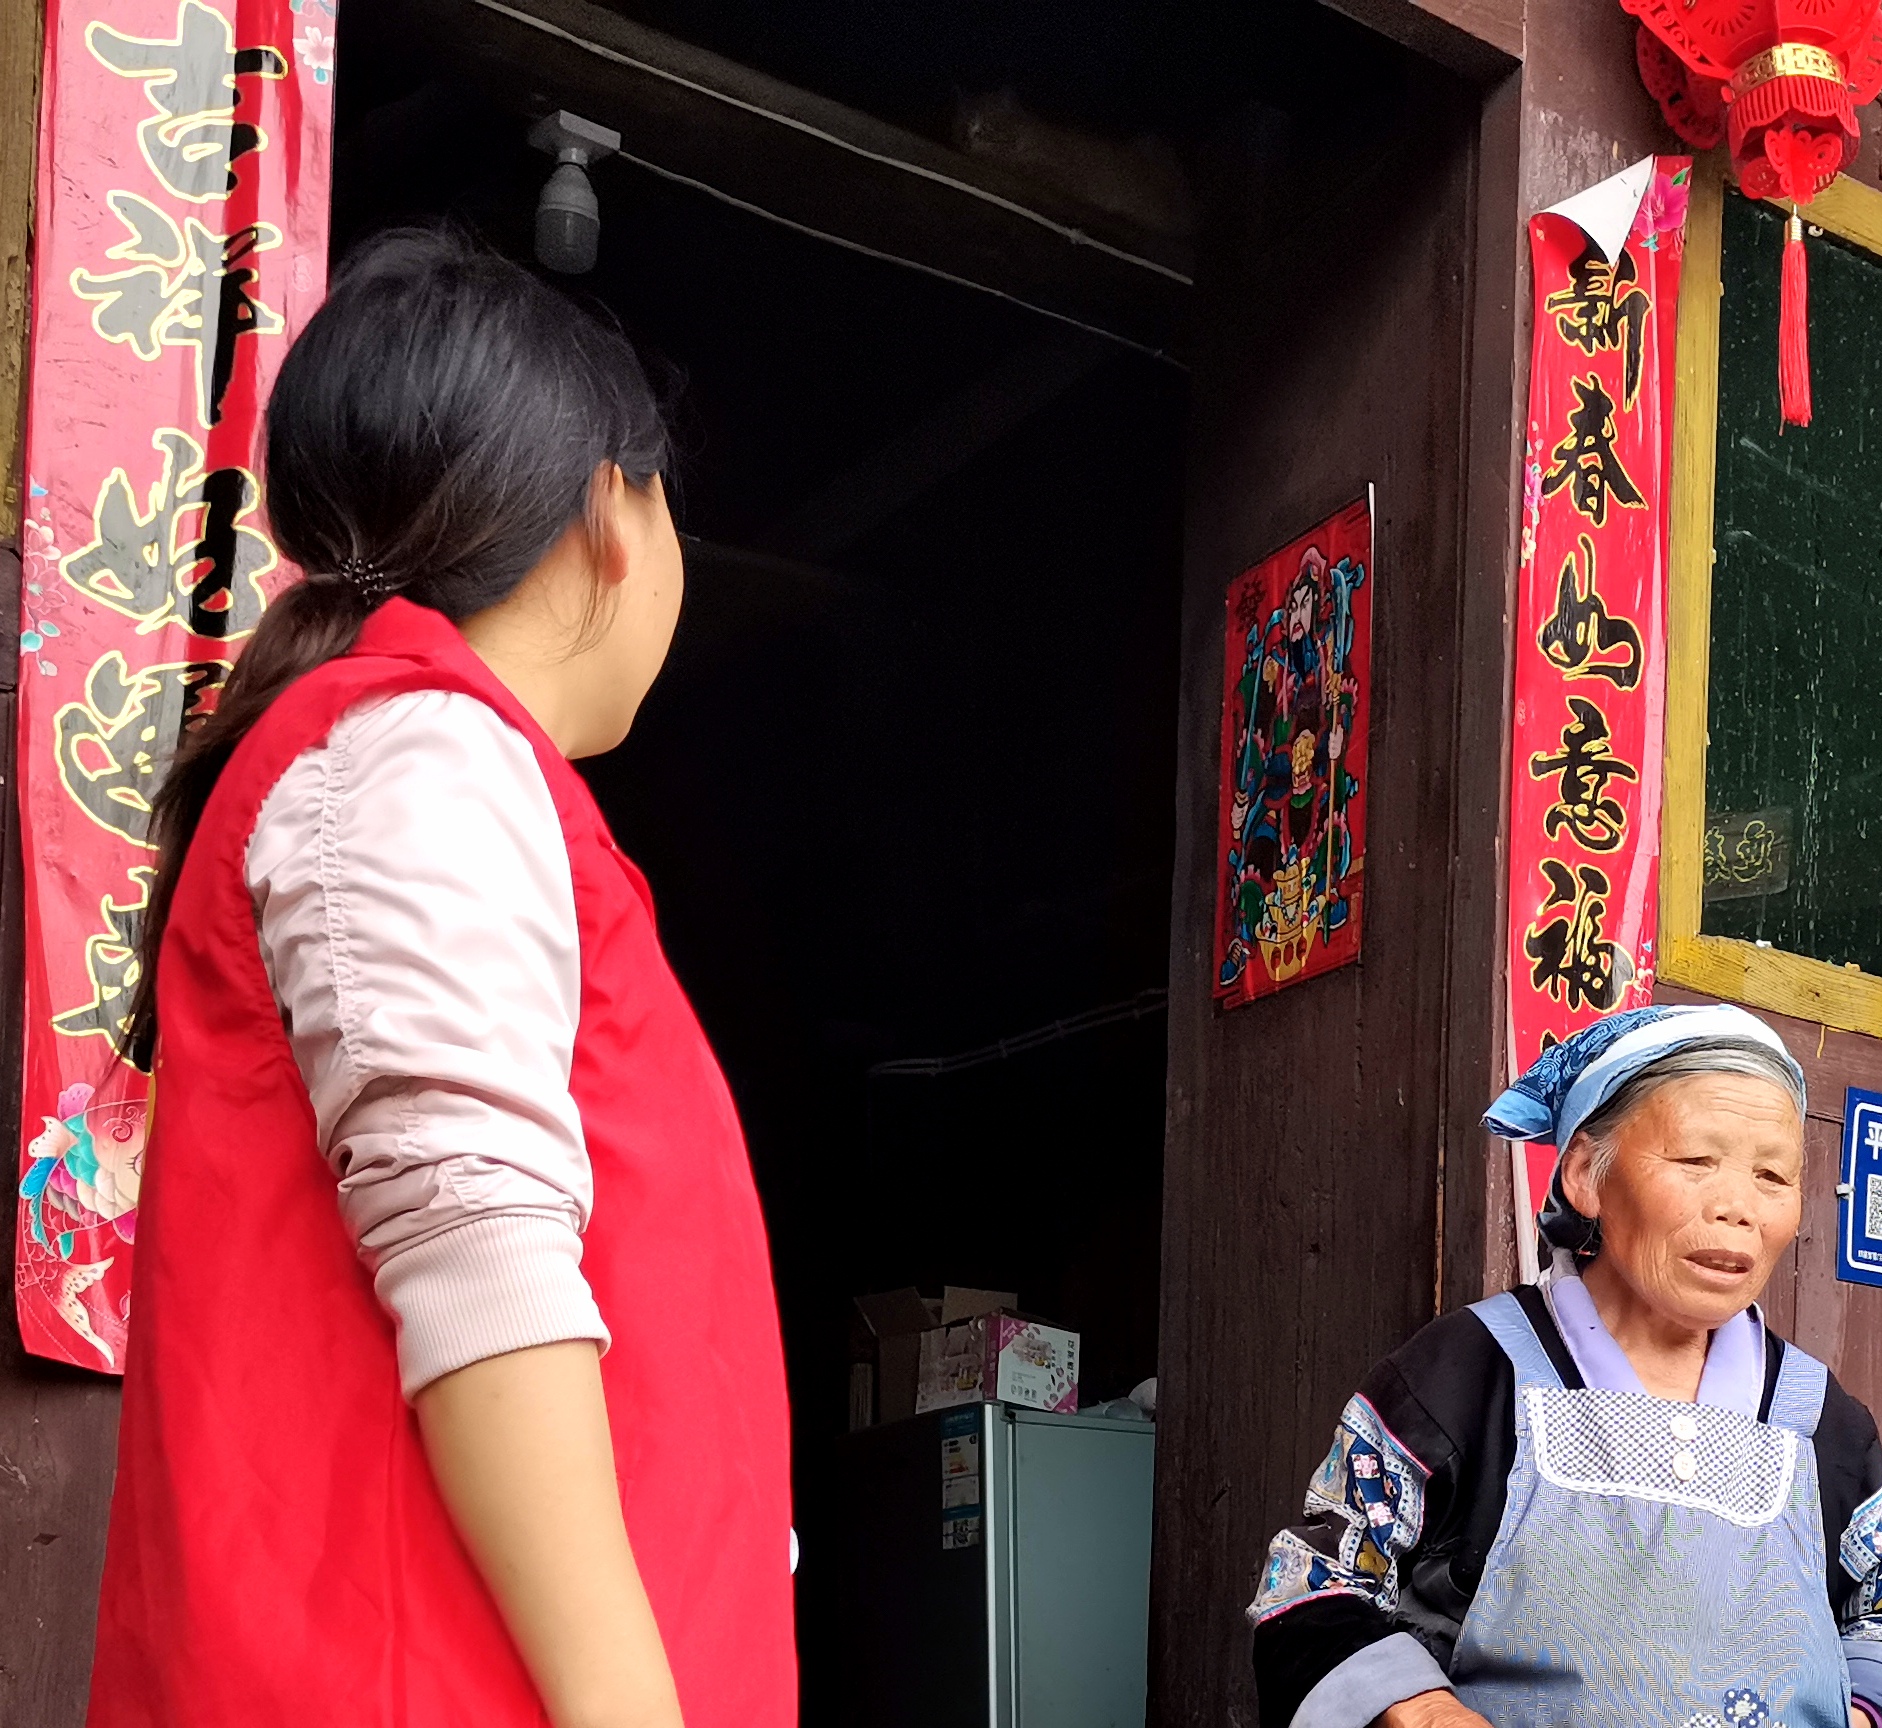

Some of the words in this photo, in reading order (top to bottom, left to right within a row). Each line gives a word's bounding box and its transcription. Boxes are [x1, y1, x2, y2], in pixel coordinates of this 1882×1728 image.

[1524, 230, 1653, 1053] 新春如意福
